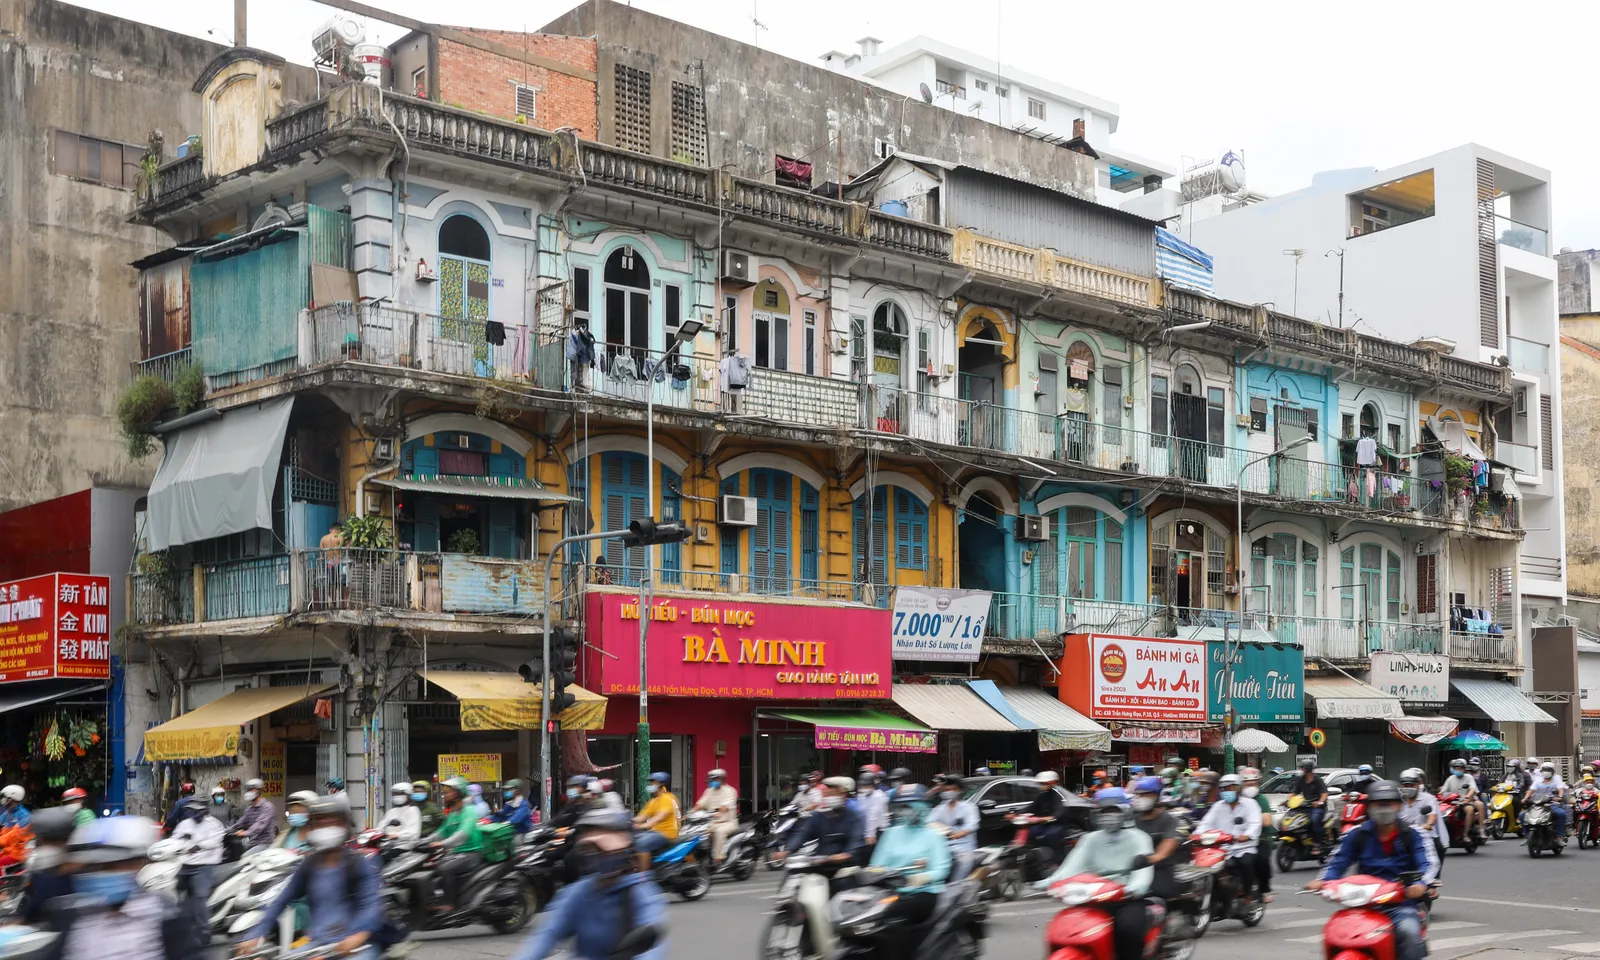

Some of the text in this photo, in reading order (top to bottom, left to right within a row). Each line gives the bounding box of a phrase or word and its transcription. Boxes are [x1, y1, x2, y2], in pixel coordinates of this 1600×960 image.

[83, 581, 107, 606] TÂN
[645, 599, 678, 622] TIẾU
[691, 604, 720, 624] BÚN
[723, 609, 755, 629] MỌC
[83, 613, 107, 634] KIM
[893, 611, 942, 638] 7.000
[80, 636, 110, 660] PHÁT
[682, 626, 827, 667] BÀ MINH
[929, 639, 939, 649] Số
[1136, 645, 1200, 664] BÁNH MÌ GÀ
[1390, 661, 1410, 673] LINH
[776, 669, 880, 686] GIAO HÀNG TẬN NƠI
[1136, 667, 1200, 693] An An
[1265, 670, 1297, 700] Tiến
[647, 684, 662, 693] 446
[680, 685, 699, 696] Hưng
[756, 688, 774, 696] HCM
[861, 690, 869, 698] 37
[877, 690, 886, 698] 37
[1105, 696, 1120, 704] BÁNH
[1120, 695, 1127, 704] MÌ
[1143, 696, 1158, 705] BÁNH
[1158, 698, 1168, 706] BAO
[1171, 697, 1186, 706] BÁNH
[1186, 698, 1195, 707] GIÒ
[843, 731, 856, 742] BÚN
[869, 731, 886, 745] Bà
[889, 732, 920, 747] Minh
[461, 763, 470, 773] 35K
[263, 782, 283, 793] 35K
